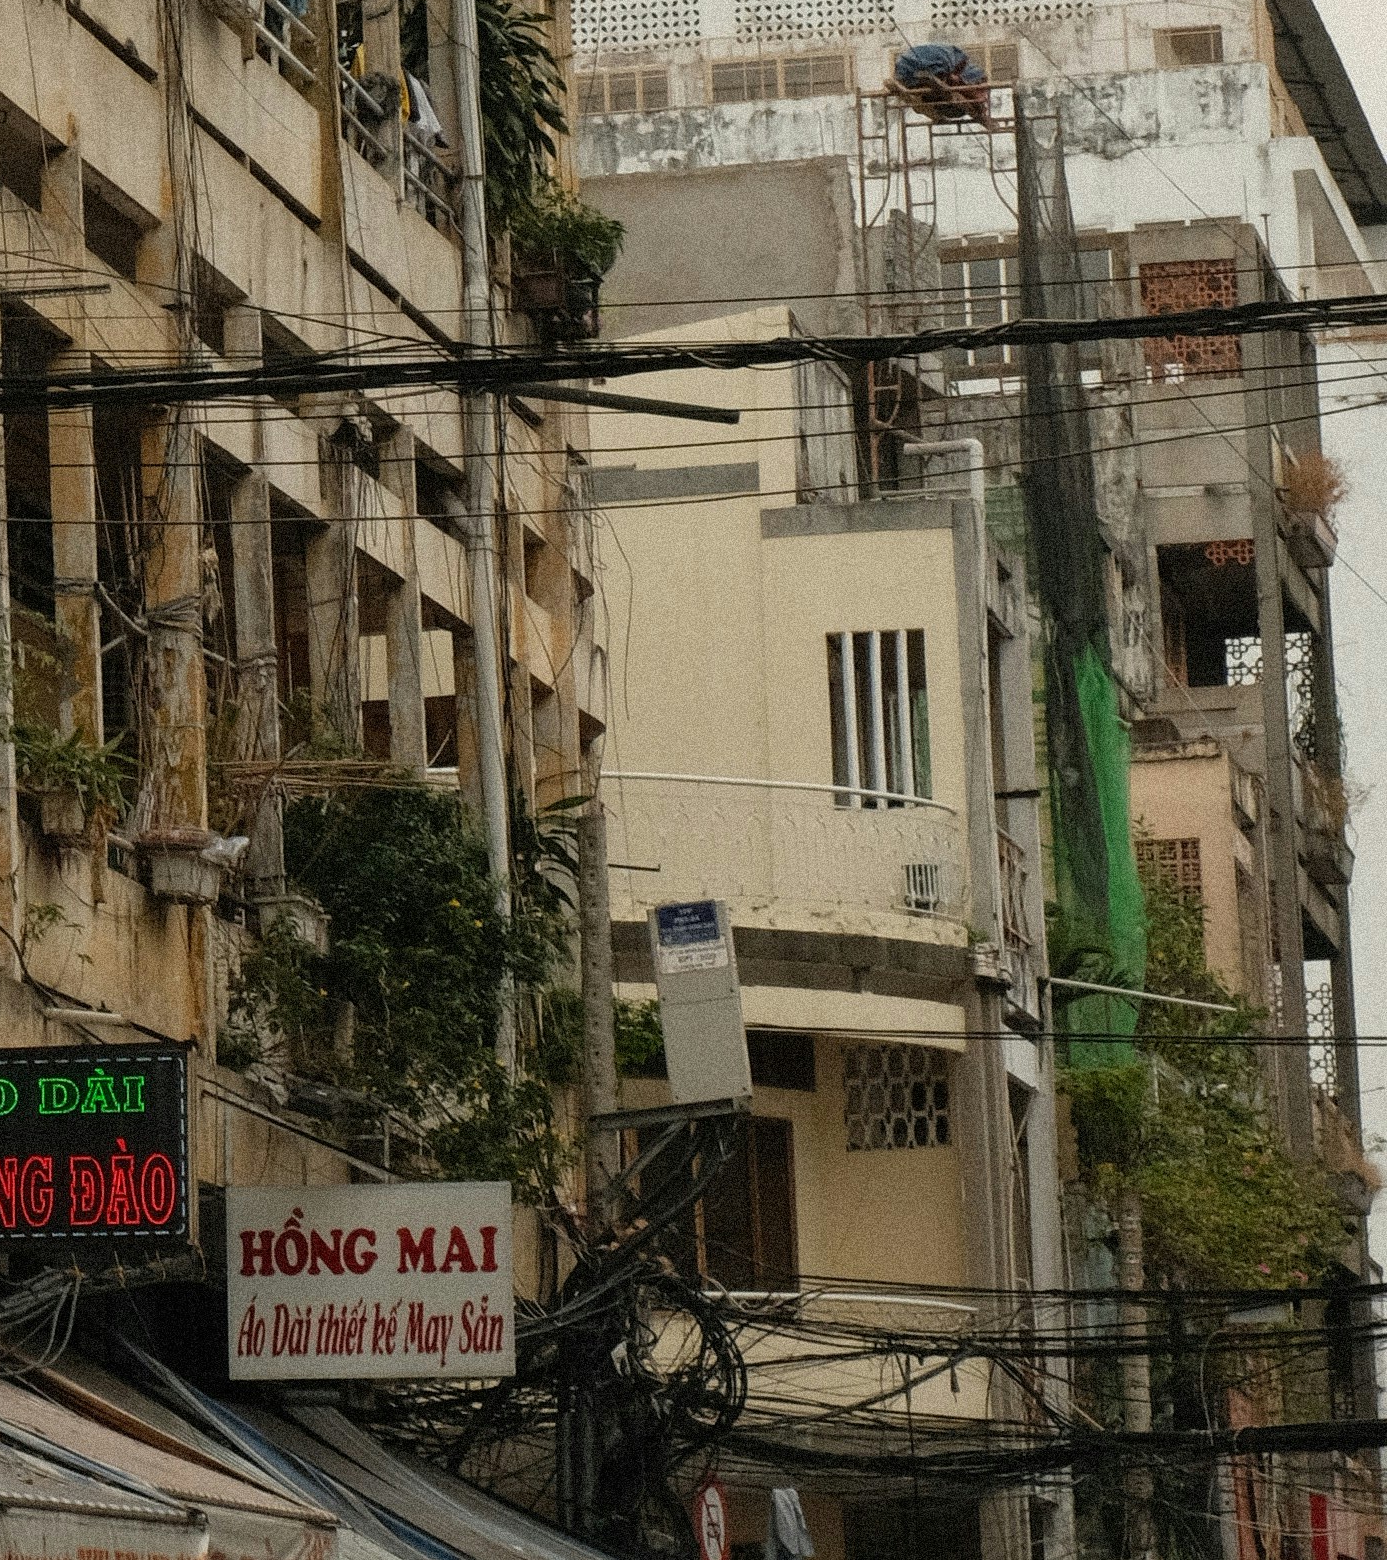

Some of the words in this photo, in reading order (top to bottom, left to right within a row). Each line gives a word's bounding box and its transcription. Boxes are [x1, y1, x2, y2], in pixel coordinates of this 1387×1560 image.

[38, 1066, 146, 1116] DÀI
[68, 1137, 178, 1226] ĐÀO
[239, 1207, 377, 1276] HỒNG
[396, 1226, 498, 1273] MAI
[237, 1293, 266, 1358] Áo
[272, 1299, 310, 1357] Dài
[315, 1295, 365, 1357] thiết
[371, 1295, 399, 1355] kế
[405, 1301, 453, 1367] May
